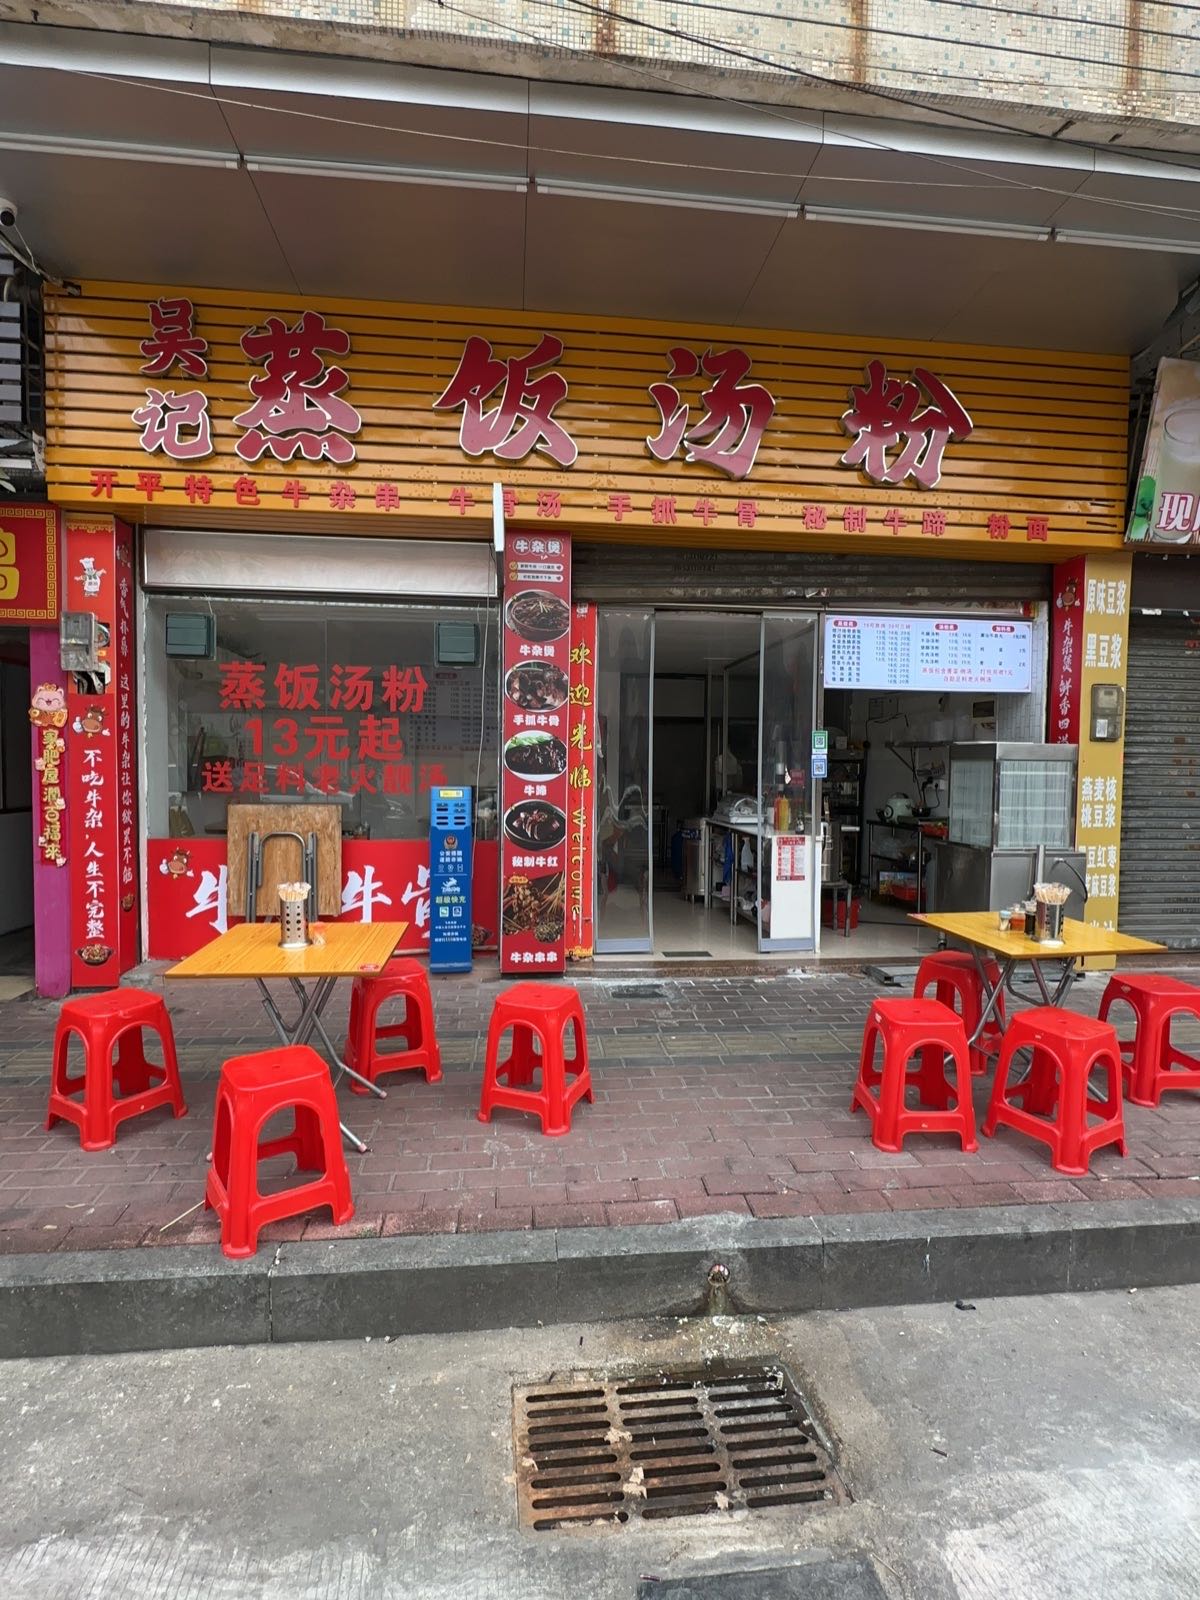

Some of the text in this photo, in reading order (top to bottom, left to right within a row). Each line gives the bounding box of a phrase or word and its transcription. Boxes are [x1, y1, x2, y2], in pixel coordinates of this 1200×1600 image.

[132, 297, 215, 461] 吴记
[233, 310, 974, 491] 蒸饭汤粉
[90, 470, 401, 512] 开平特色牛杂串
[606, 494, 758, 528] 手抓牛骨
[802, 504, 947, 537] 秘制牛蹄
[986, 513, 1049, 541] 粉面
[1154, 493, 1200, 533] 现
[1086, 579, 1127, 616] 原味豆浆
[1085, 633, 1123, 669] 黑豆浆
[219, 661, 429, 713] 蒸饭汤粉
[244, 713, 405, 761] 13元起
[513, 714, 560, 727] 手抓牛骨
[1081, 776, 1117, 801] 燕麦核
[1081, 804, 1116, 828] 桃豆浆
